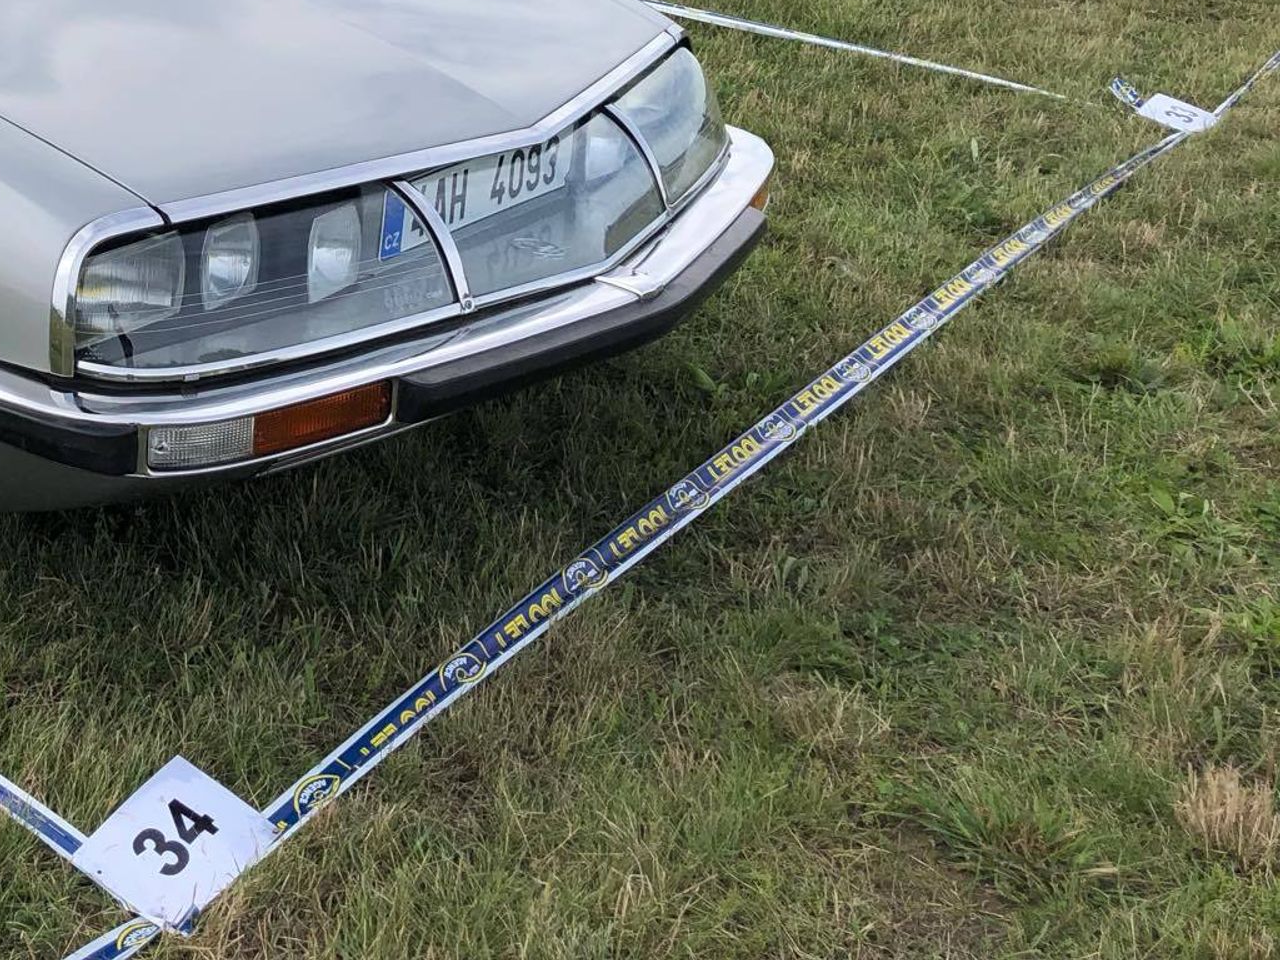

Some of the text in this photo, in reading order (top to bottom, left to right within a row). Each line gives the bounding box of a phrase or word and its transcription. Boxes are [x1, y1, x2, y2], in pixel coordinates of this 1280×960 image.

[490, 135, 560, 205] 4093
[385, 232, 400, 251] CZ
[299, 779, 328, 804] AGENCE
[133, 798, 219, 876] 34
